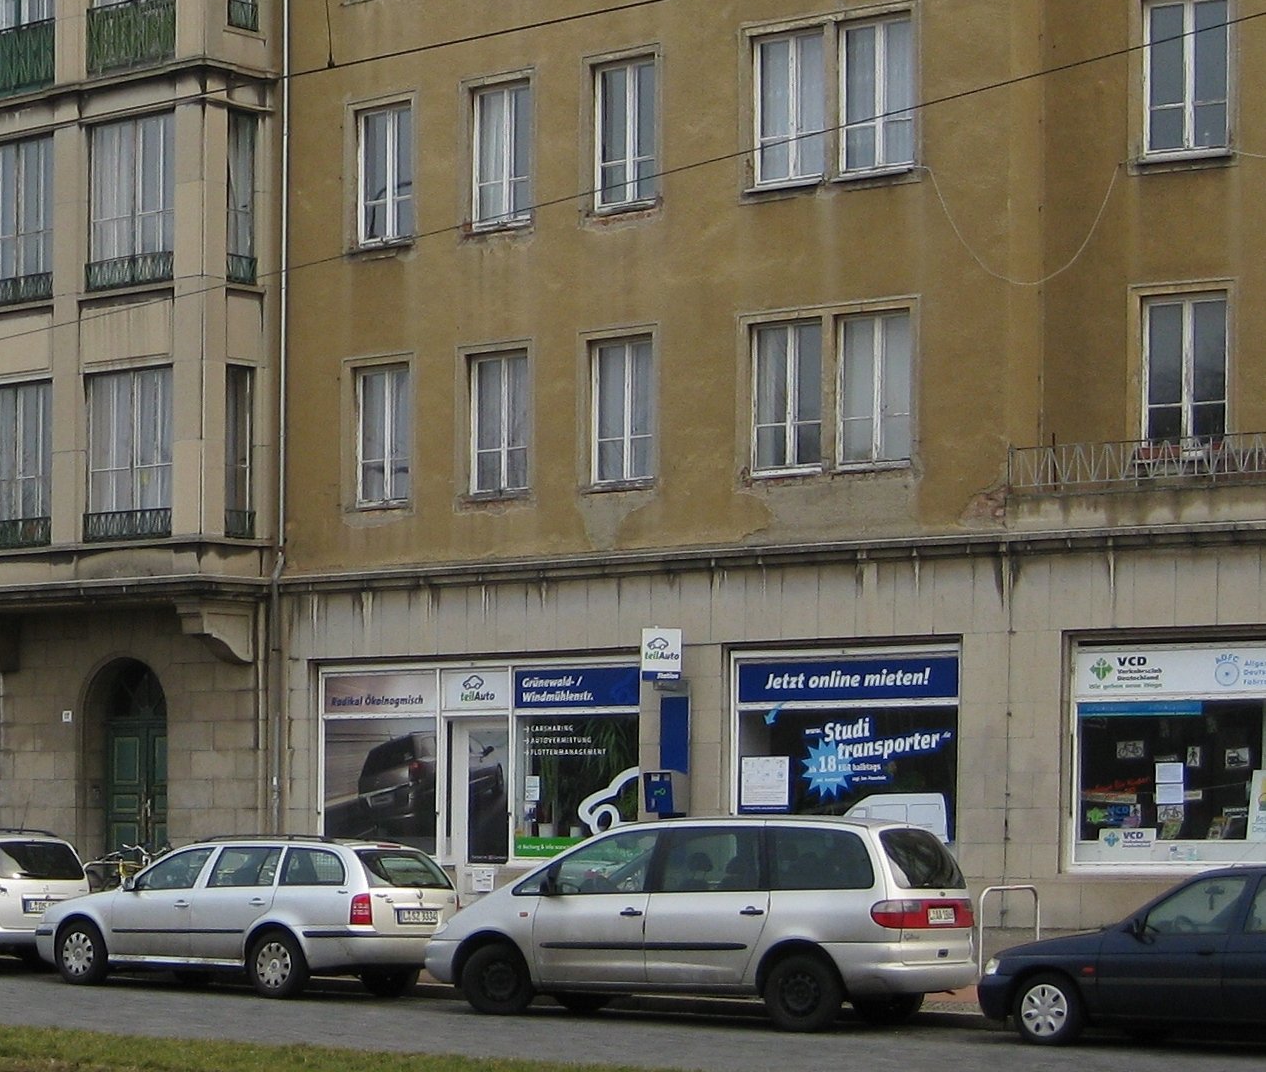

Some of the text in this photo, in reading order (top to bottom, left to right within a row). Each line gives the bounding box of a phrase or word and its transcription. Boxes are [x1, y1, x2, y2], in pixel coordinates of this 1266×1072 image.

[645, 651, 680, 659] teilAuto
[1117, 656, 1147, 666] VCD
[522, 676, 575, 688] Grünewald-
[765, 667, 931, 690] Jetzt online mieten!
[332, 695, 362, 706] Radikal
[460, 690, 495, 701] teilAuto
[522, 691, 594, 702] Windmühlenstr.
[531, 724, 573, 732] CARSHARING
[824, 717, 870, 742] Studi
[530, 736, 591, 744] AUTOVERMIETUNG
[837, 731, 940, 759] transporter
[530, 748, 607, 756] FLOTTENMANAGEMENT
[818, 755, 836, 772] 18
[1123, 831, 1143, 839] VCD
